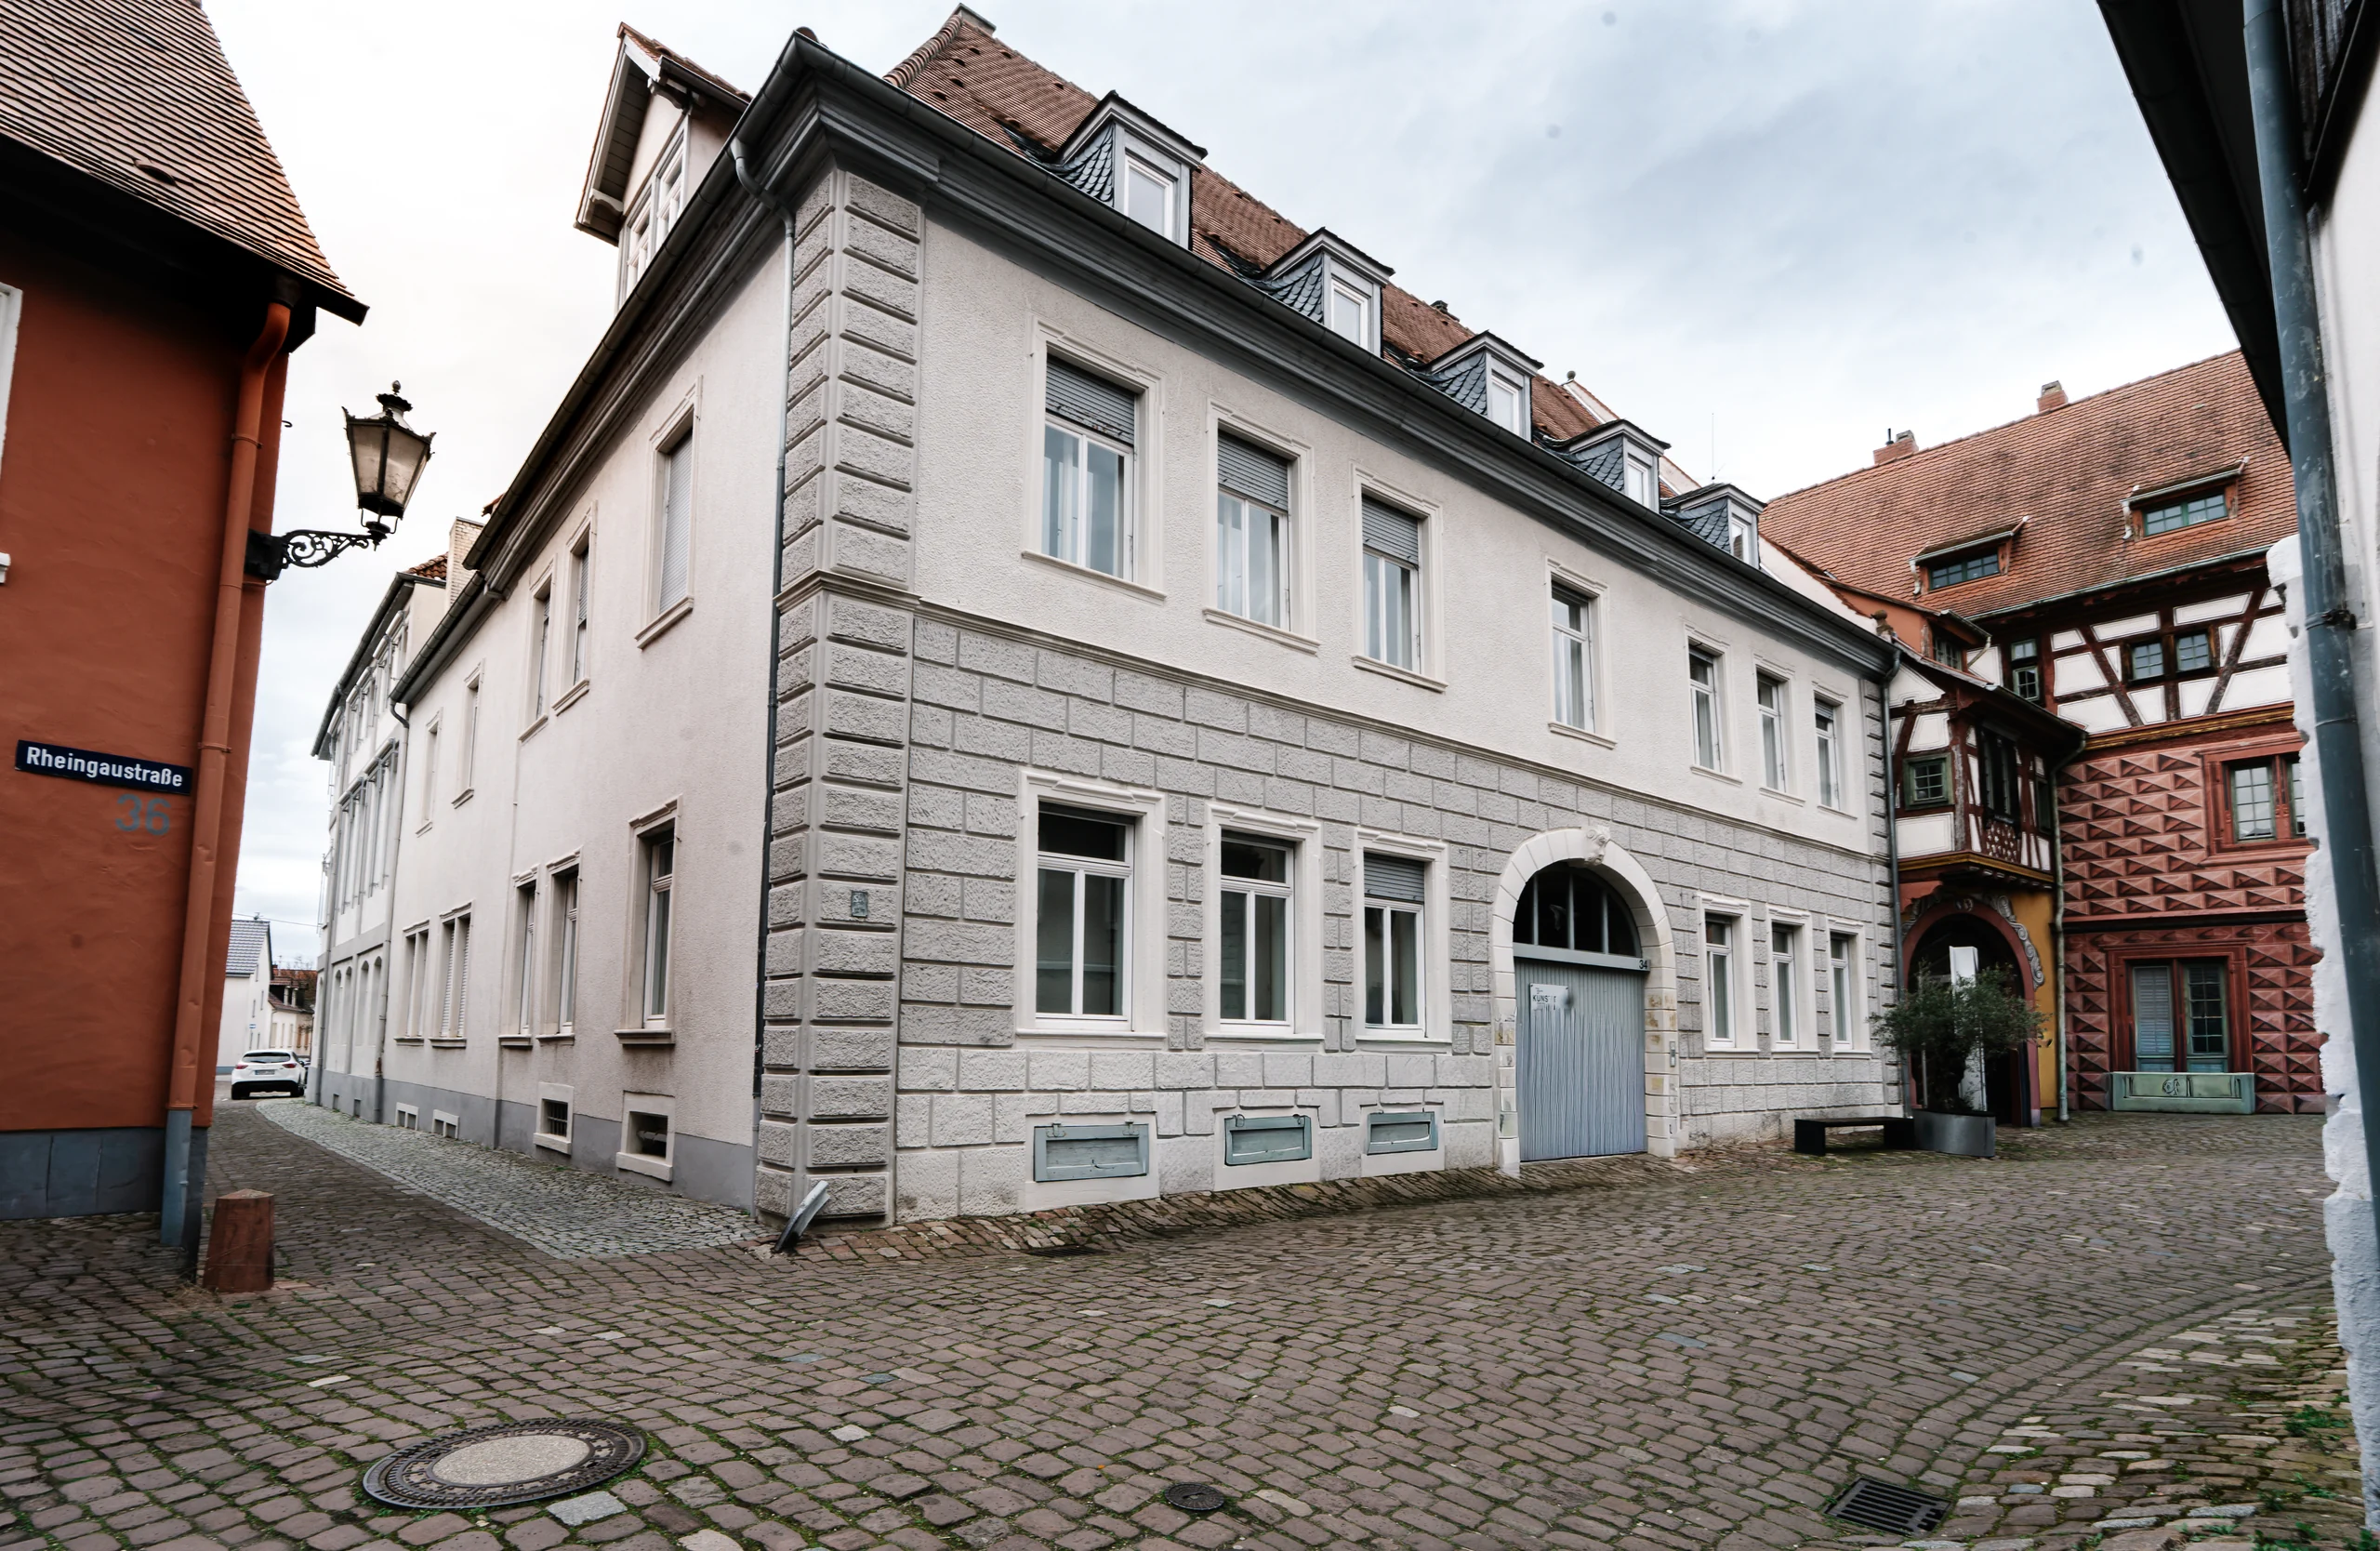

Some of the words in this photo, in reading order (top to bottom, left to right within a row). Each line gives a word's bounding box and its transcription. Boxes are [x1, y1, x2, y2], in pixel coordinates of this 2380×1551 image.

[26, 746, 183, 788] Rheingaustraße
[114, 793, 172, 836] 36
[1639, 959, 1648, 970] 34
